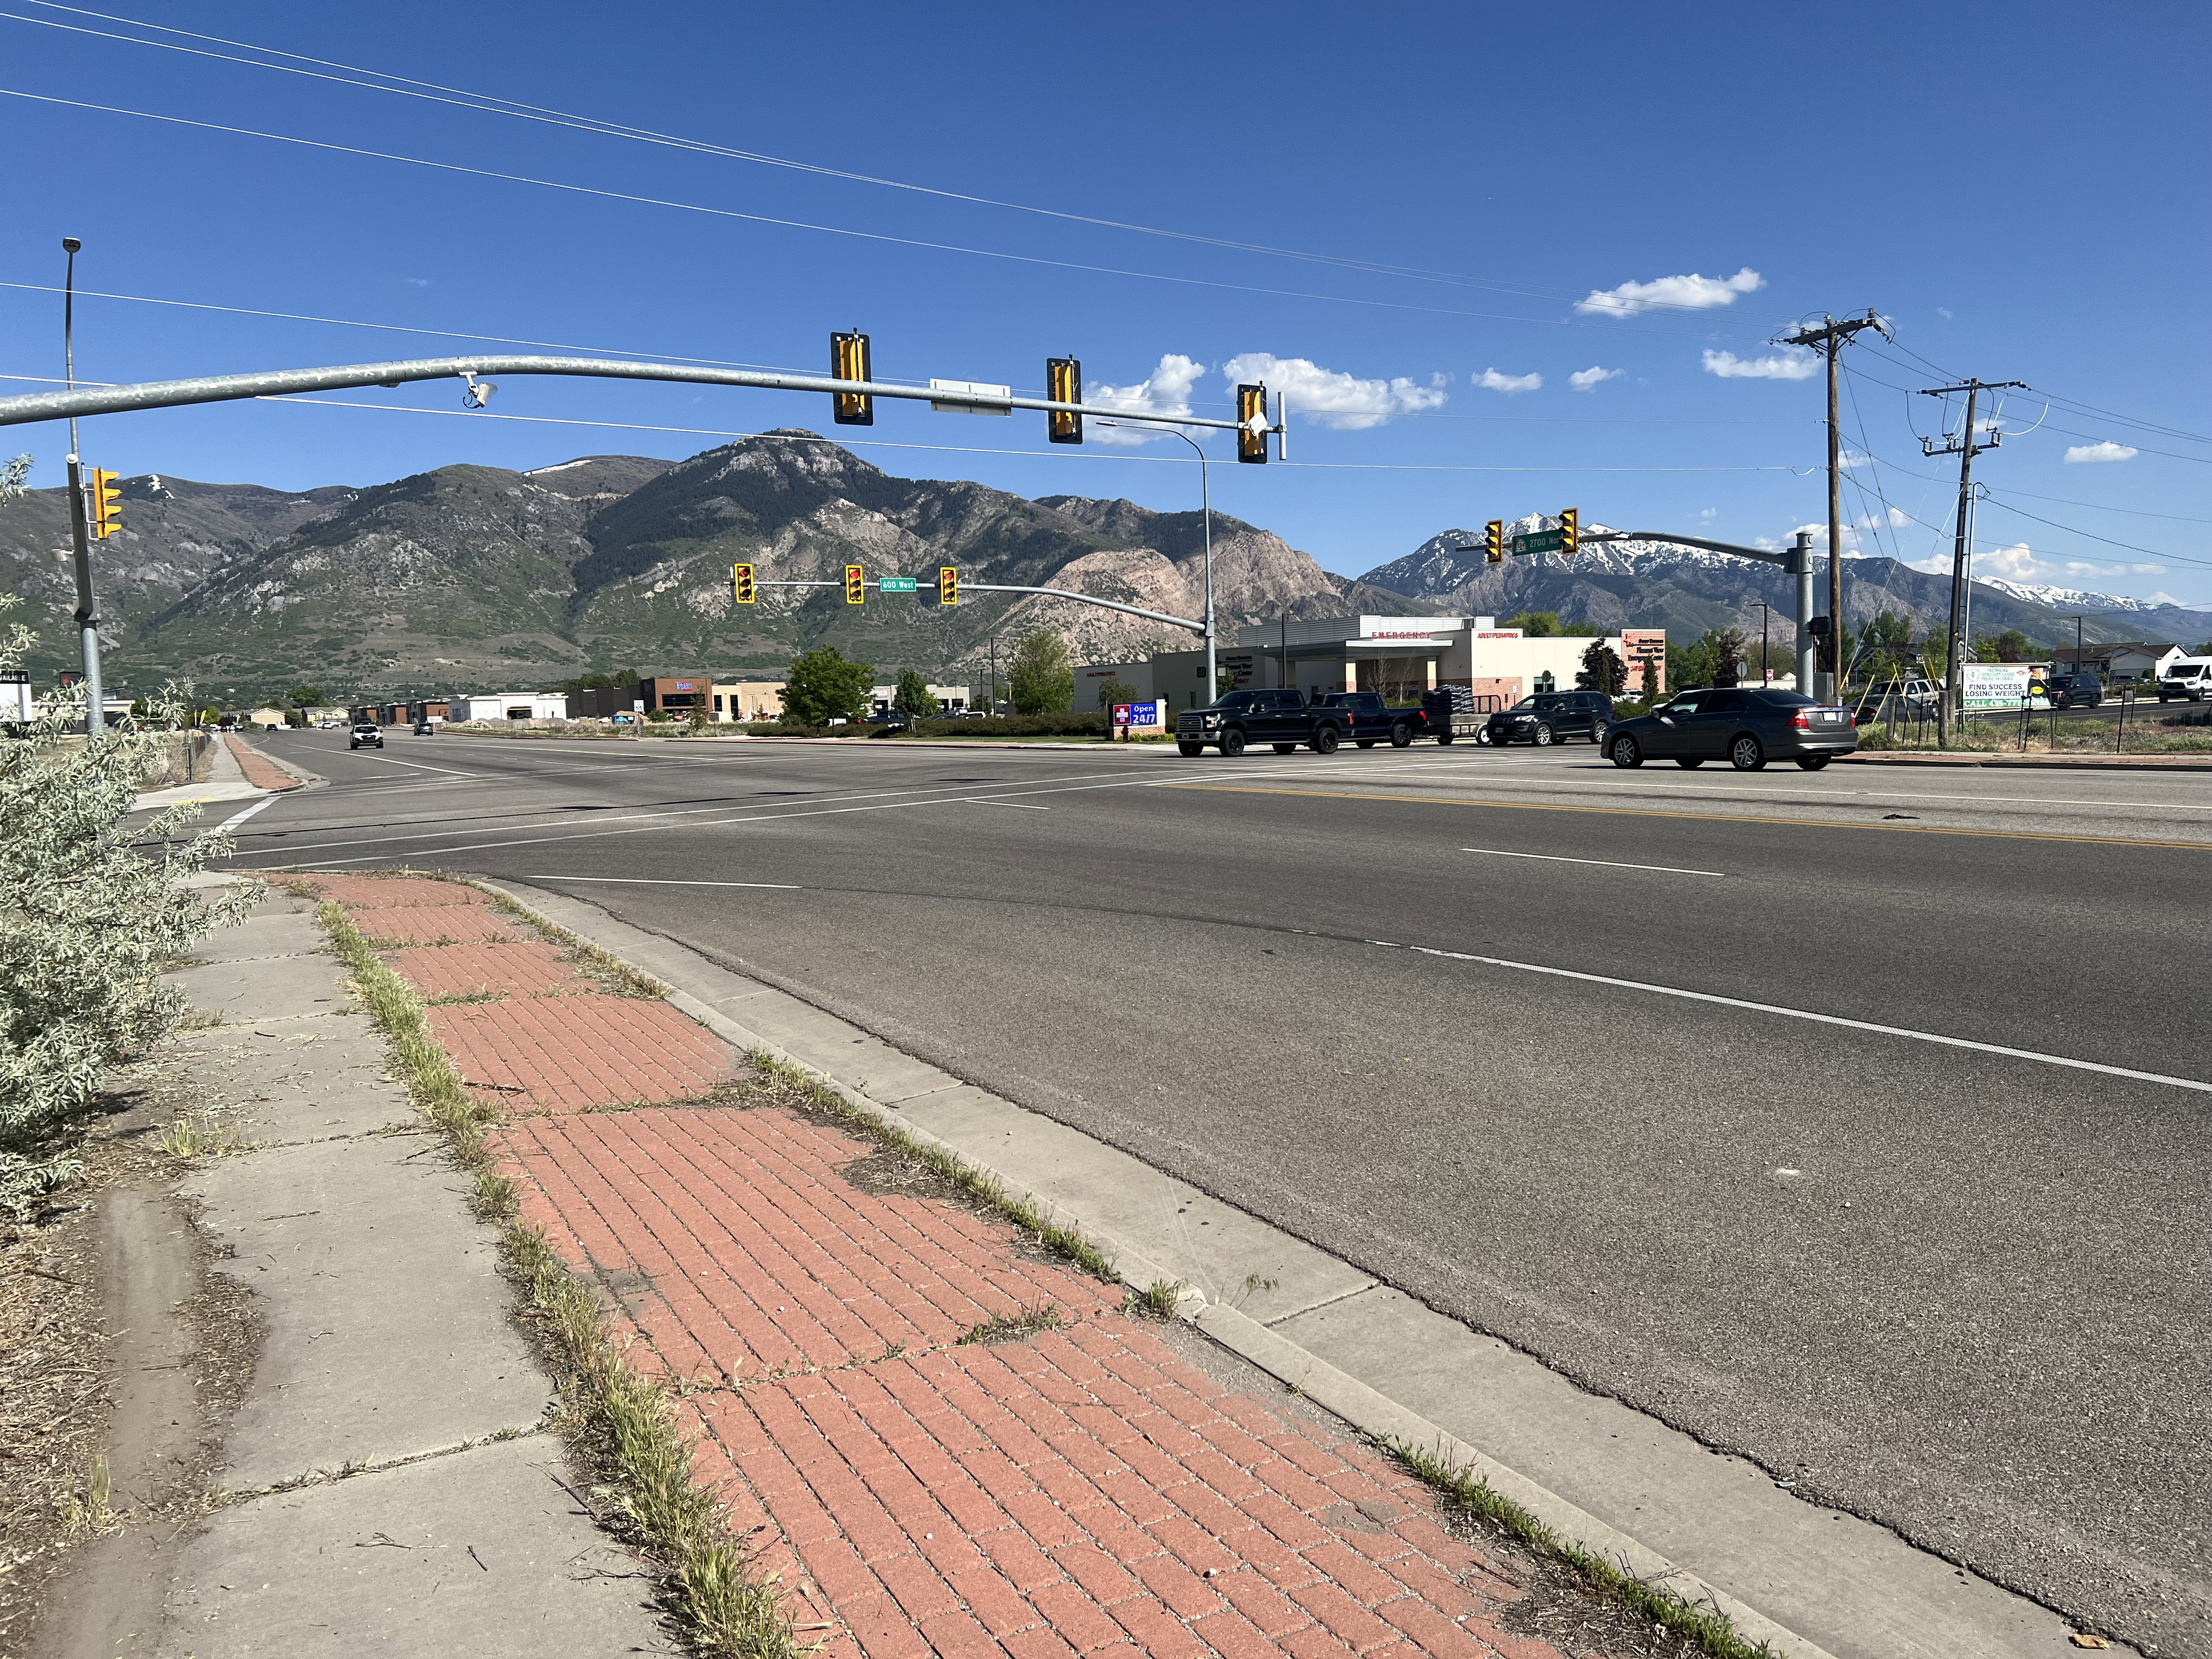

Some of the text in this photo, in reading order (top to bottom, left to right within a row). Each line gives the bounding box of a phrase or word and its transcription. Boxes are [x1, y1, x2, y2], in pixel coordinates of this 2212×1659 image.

[1530, 538, 1546, 548] 2700
[1133, 705, 1154, 714] Open
[1133, 714, 1155, 724] 24/7
